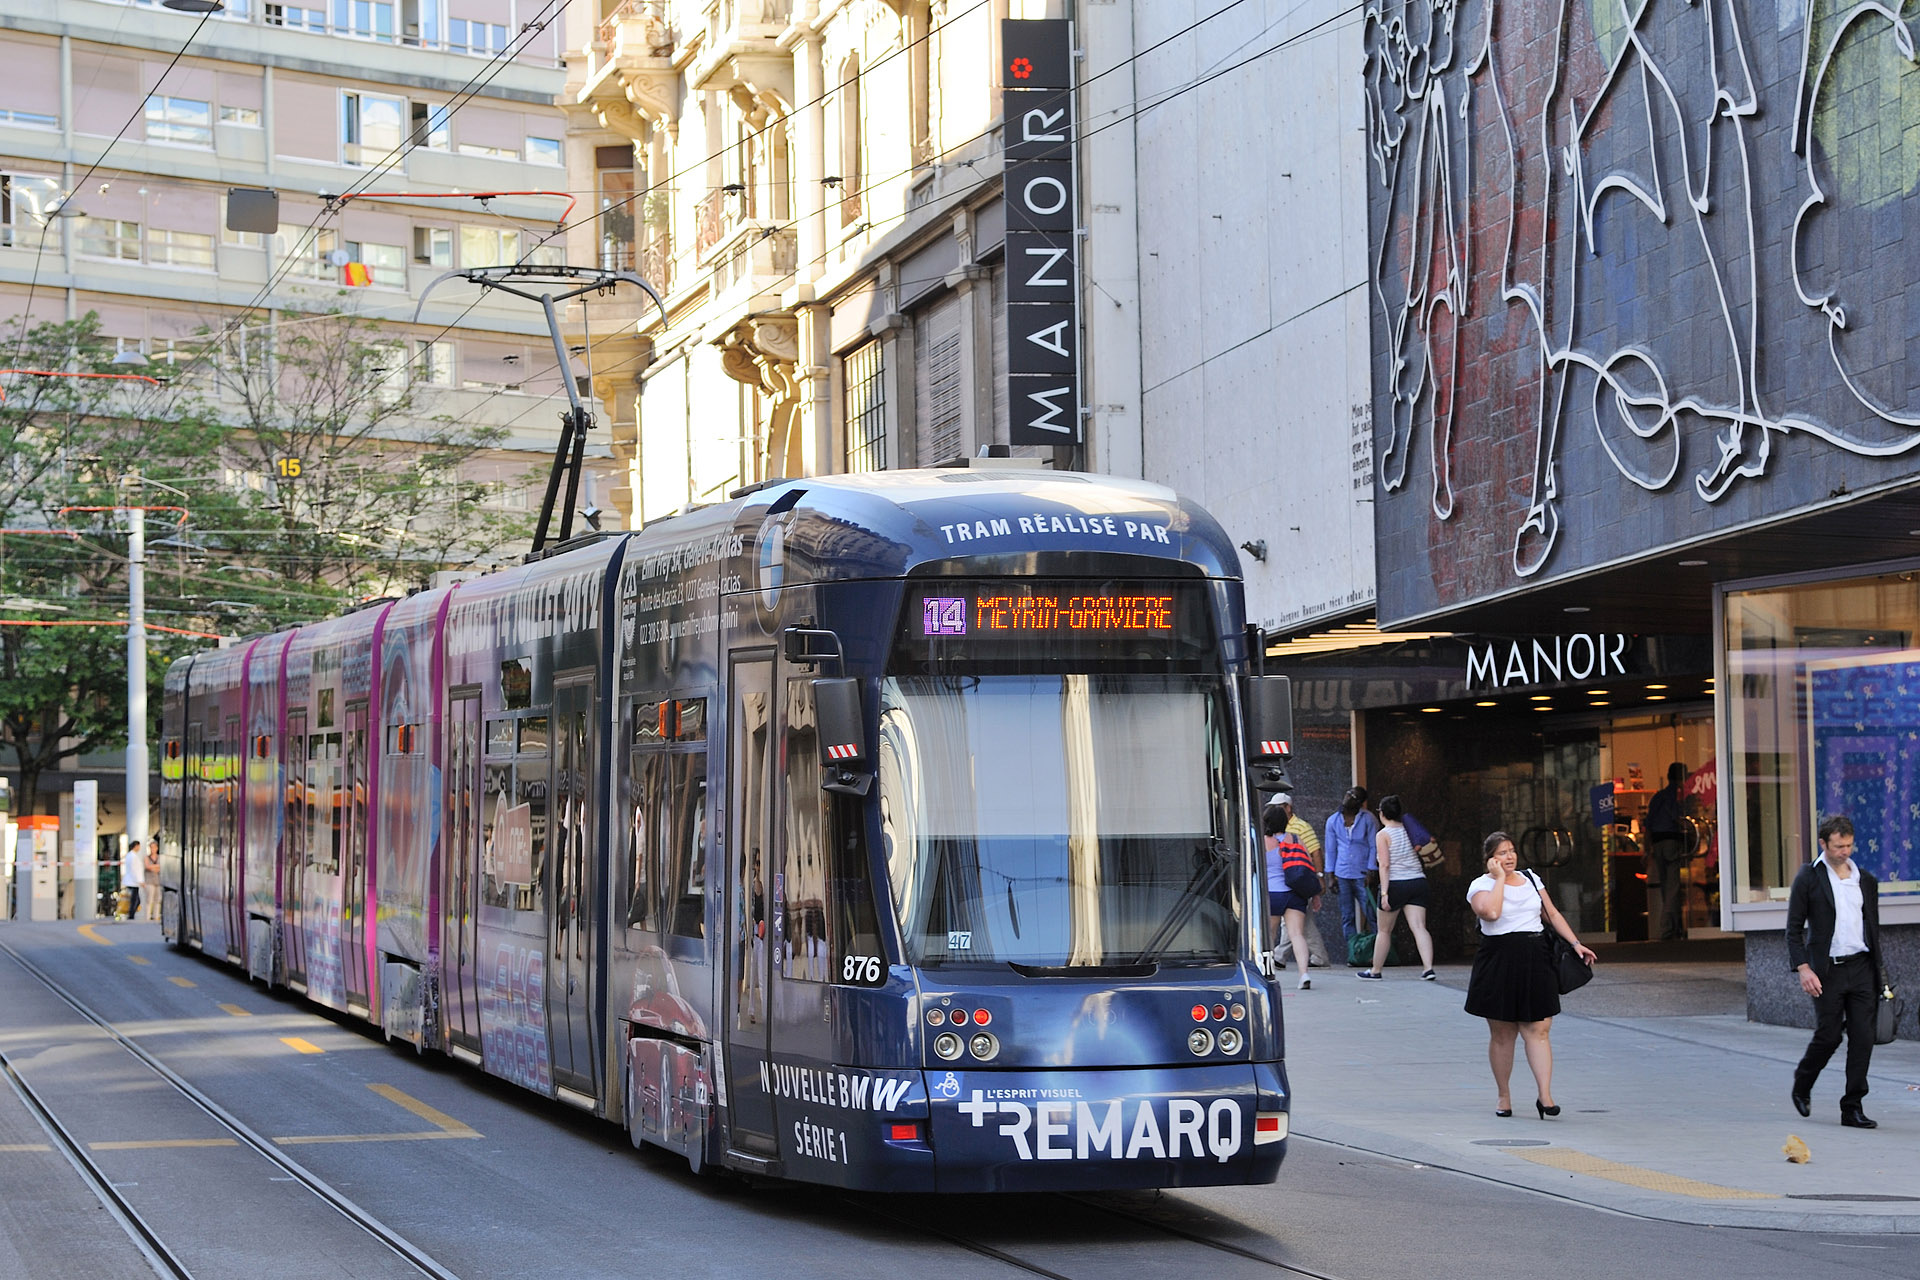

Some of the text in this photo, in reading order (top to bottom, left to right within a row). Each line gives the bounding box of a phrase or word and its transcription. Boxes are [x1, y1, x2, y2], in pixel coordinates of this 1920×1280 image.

[1022, 107, 1070, 435] MANOR
[277, 458, 301, 477] 15
[940, 514, 1171, 545] TRAM RÉALISÉ PAR
[563, 567, 600, 634] 2012
[925, 597, 1172, 633] 14 MEYRIN-GRAVIERE
[1465, 633, 1626, 690] MANOR
[949, 934, 970, 948] 47
[843, 954, 881, 982] 876
[760, 1060, 836, 1106] NOUVELLE
[838, 1073, 912, 1112] BMW
[987, 1088, 1082, 1099] L'ESPRIT VISUEL
[794, 1116, 848, 1164] SÉRIE 1
